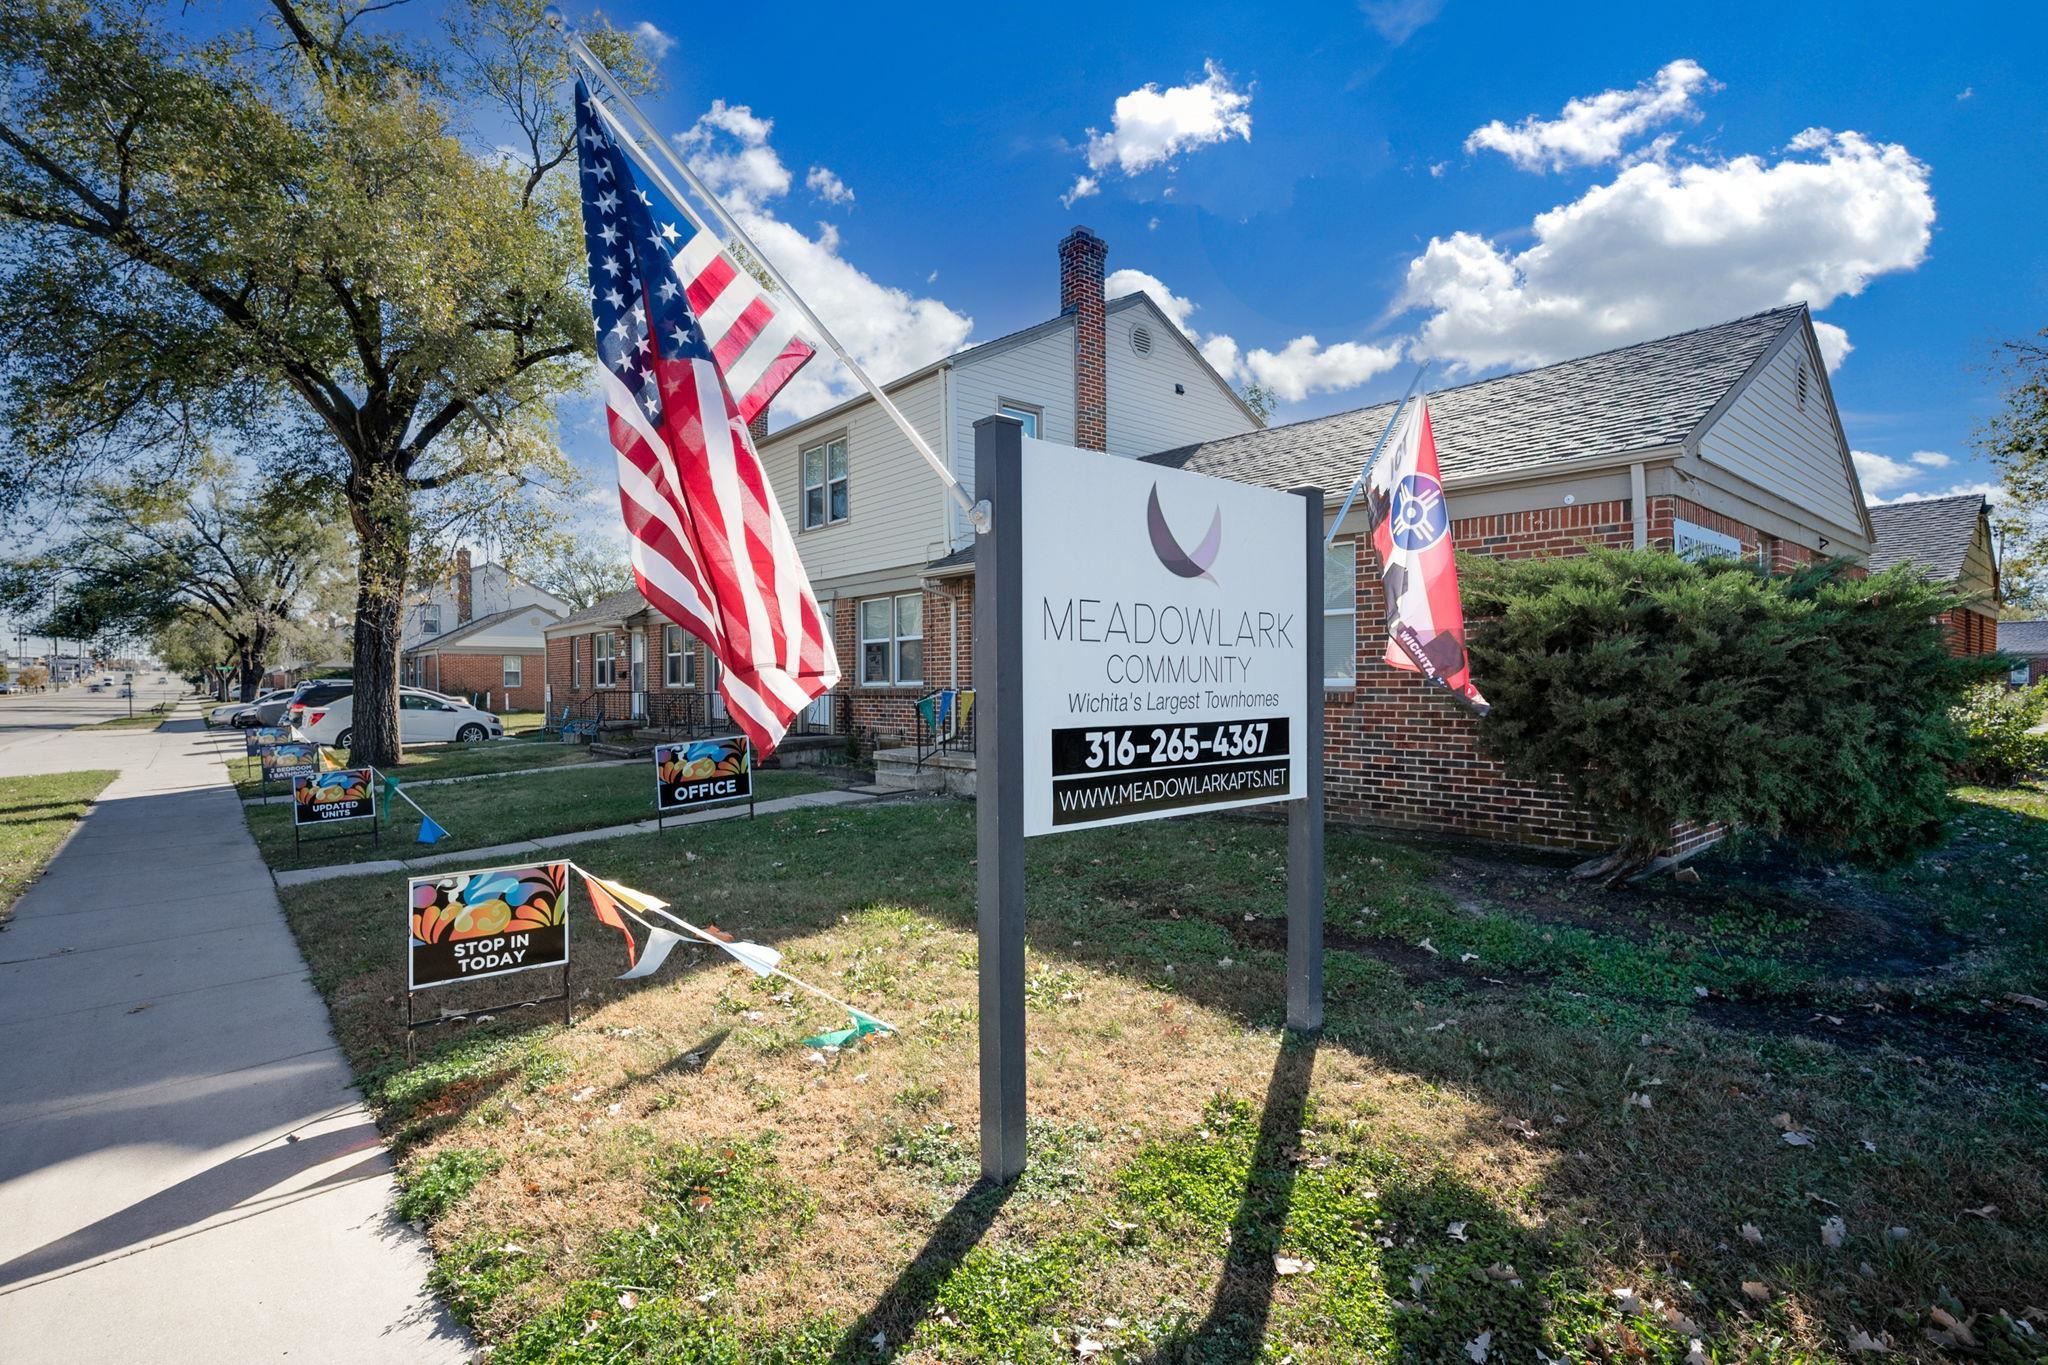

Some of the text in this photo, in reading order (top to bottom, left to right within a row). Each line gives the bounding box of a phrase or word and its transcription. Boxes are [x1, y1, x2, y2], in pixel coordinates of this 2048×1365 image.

[1044, 596, 1294, 649] MEADOWLARK
[1399, 630, 1436, 679] WICHITA,
[1107, 654, 1252, 684] COMMUNITY
[1069, 689, 1279, 715] Wichita's Largest Townhomes
[1085, 722, 1269, 769] 316-265-4367
[276, 765, 312, 773] BEDROOM
[674, 779, 736, 801] OFFICE
[1059, 768, 1287, 812] WWW.MEADOWLARKAPTS.NET
[312, 801, 358, 812] UPDATED
[321, 809, 350, 819] UNITS
[454, 933, 529, 957] STOP IN
[458, 949, 526, 972] TODAY
